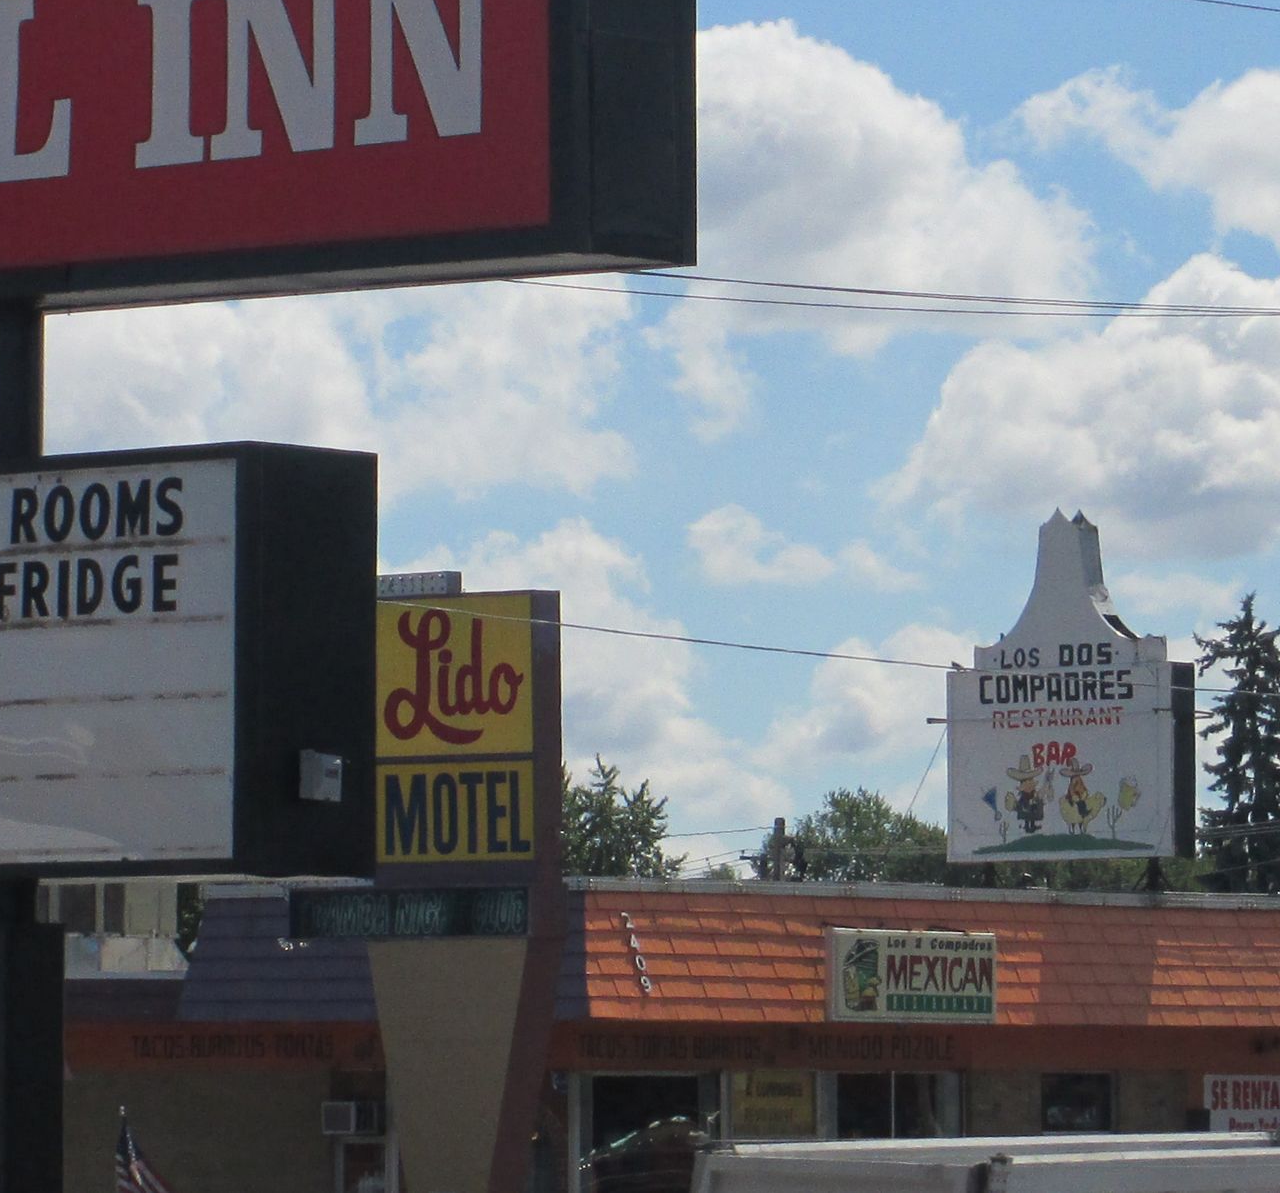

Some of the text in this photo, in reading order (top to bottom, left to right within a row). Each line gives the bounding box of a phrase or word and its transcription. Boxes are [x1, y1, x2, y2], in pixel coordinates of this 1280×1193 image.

[10, 477, 184, 544] ROOMS
[1000, 643, 1112, 669] LOS DOS
[383, 609, 524, 745] Lido
[979, 670, 1134, 704] COMPADRES
[992, 706, 1124, 729] RESTAURANT
[1031, 741, 1077, 768] BAR
[384, 770, 531, 856] MOTEL
[620, 912, 652, 993] 2409
[886, 954, 993, 993] MEXICAN
[1211, 1079, 1228, 1111] SE
[1232, 1080, 1280, 1110] RENTA
